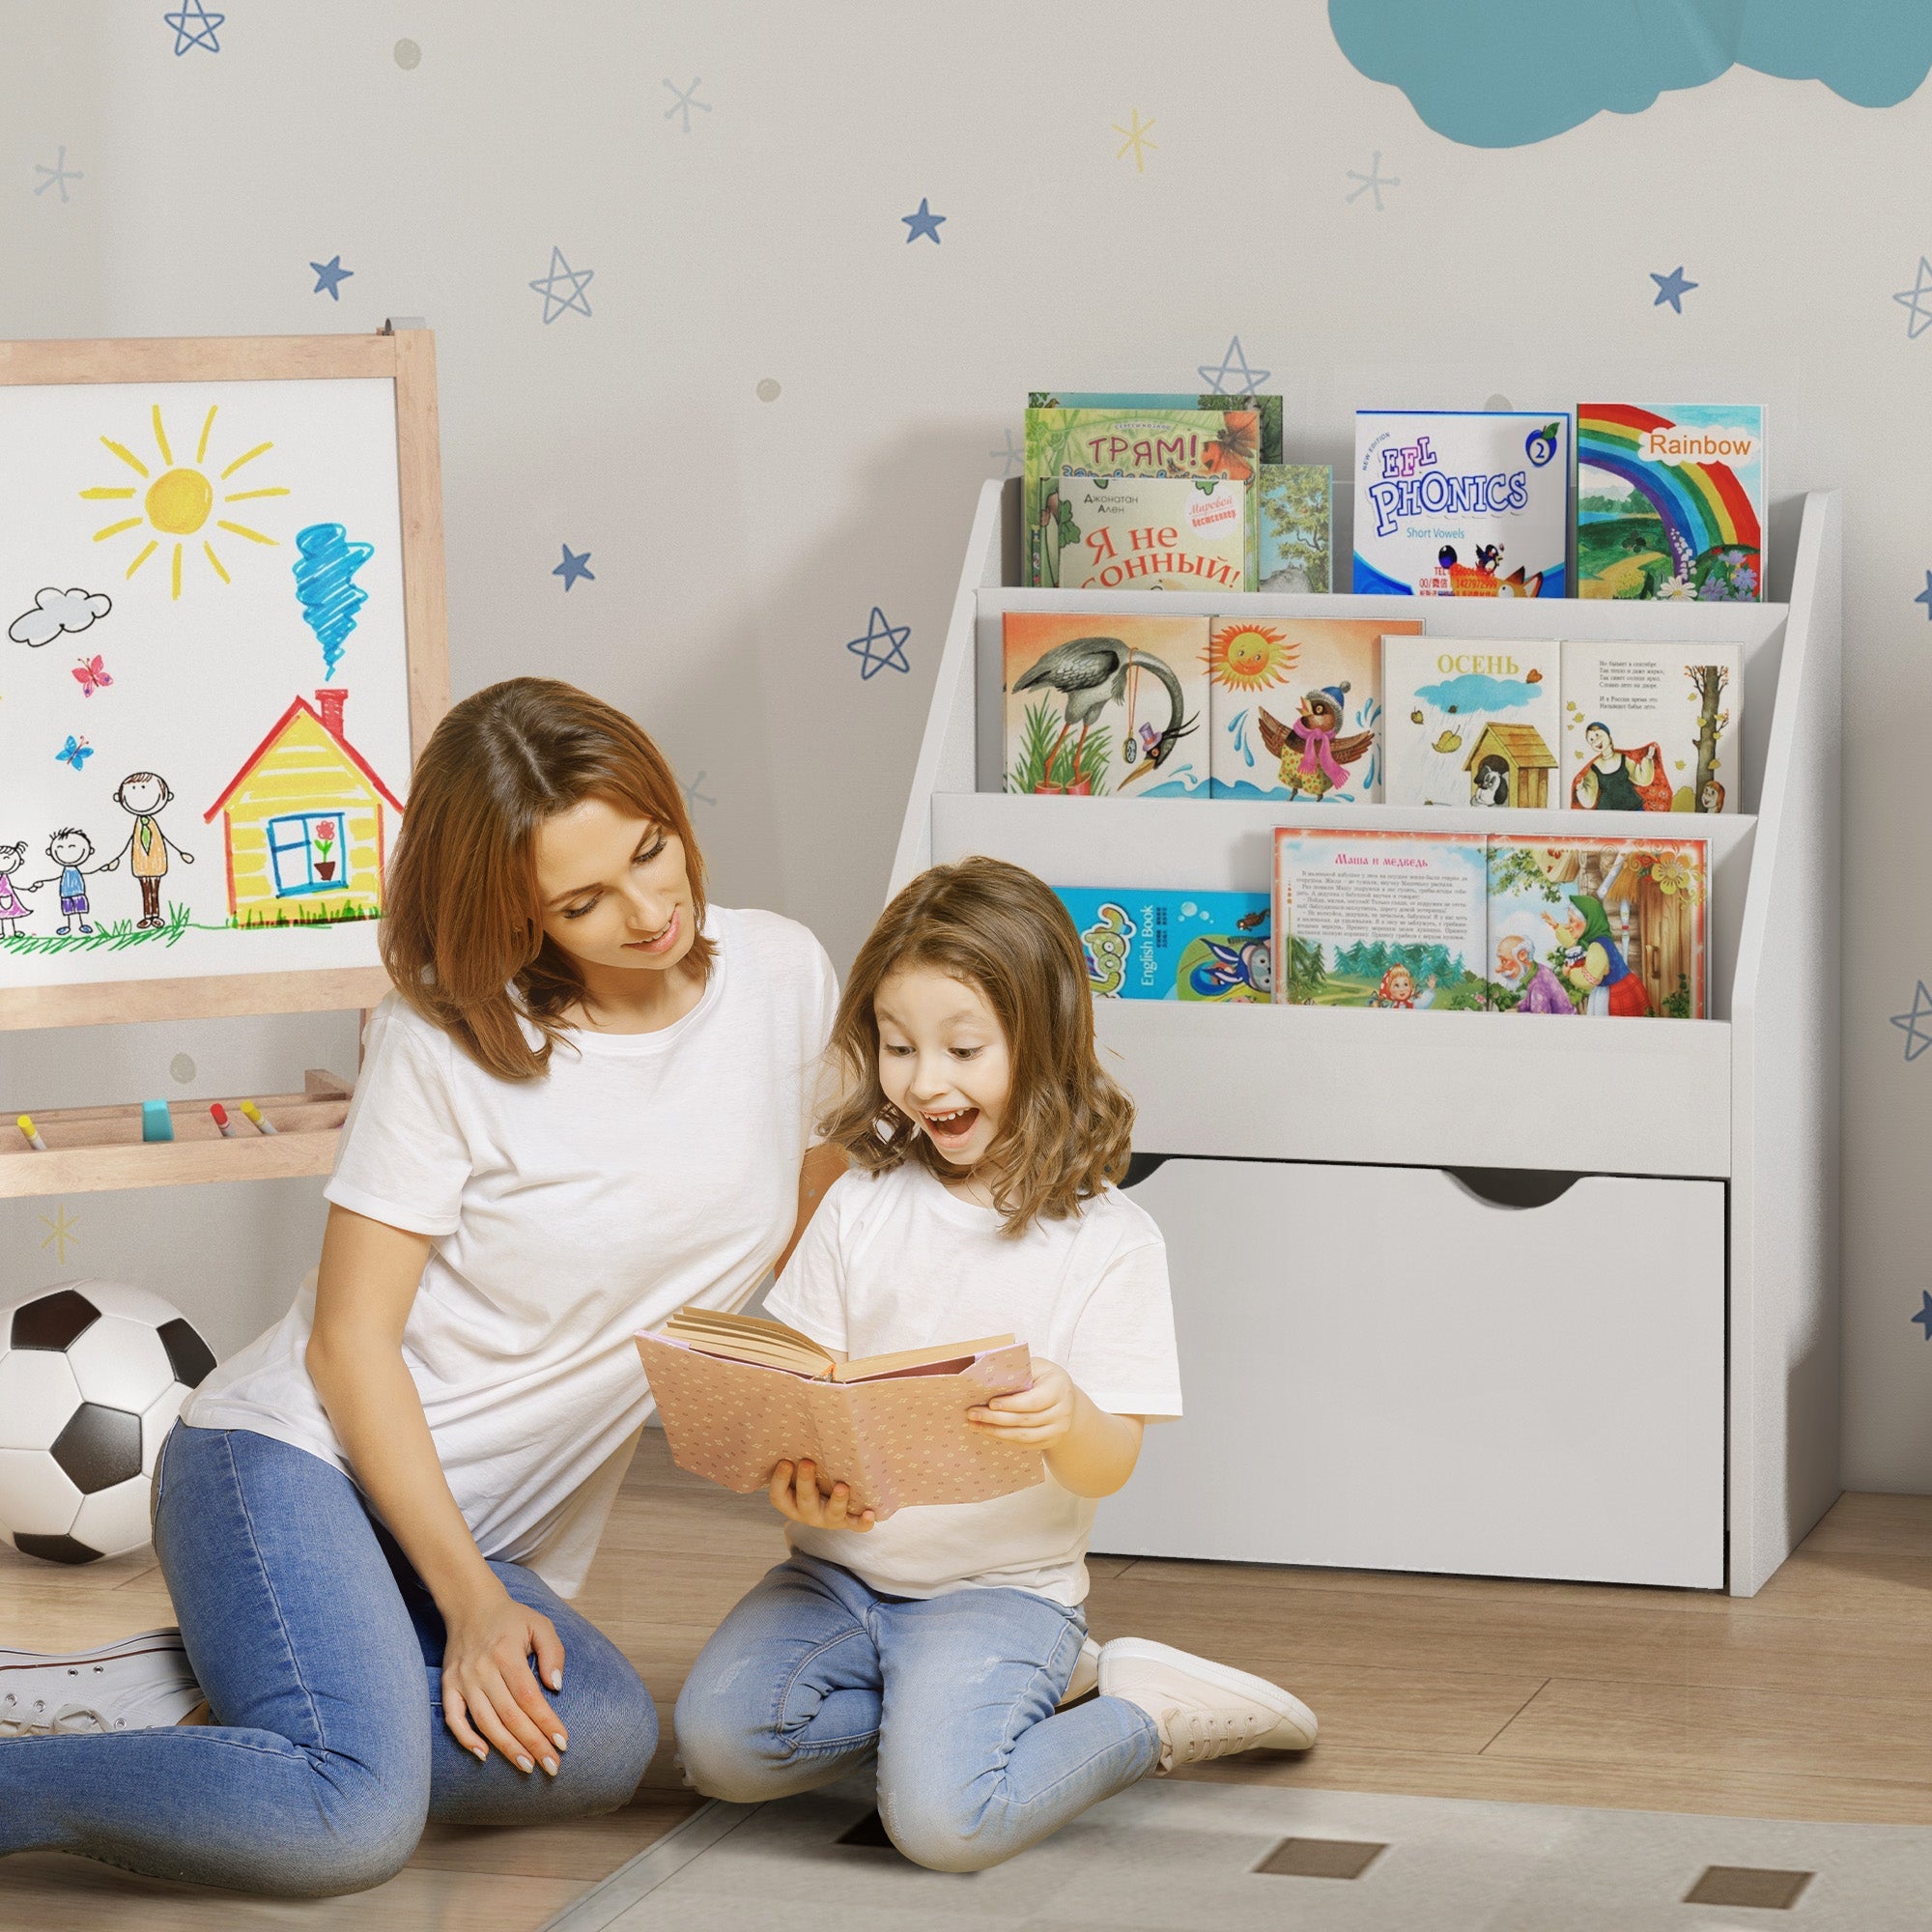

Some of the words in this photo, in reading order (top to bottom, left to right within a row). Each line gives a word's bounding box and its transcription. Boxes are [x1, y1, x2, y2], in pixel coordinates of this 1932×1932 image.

[1088, 434, 1198, 467] ТРЯМ!
[1368, 431, 1391, 453] EDITION
[1535, 441, 1545, 459] 2
[1649, 434, 1752, 456] Rainbow
[1382, 436, 1437, 479] EFL
[1083, 494, 1139, 504] Джонатан
[1368, 470, 1529, 538] PHONICS
[1406, 526, 1431, 539] Short
[1433, 527, 1465, 539] Vowels
[1085, 526, 1119, 567] Я
[1127, 526, 1179, 552] не
[1436, 653, 1520, 675] ОСЕНЬ
[1334, 853, 1369, 866] Маша
[1382, 857, 1429, 868] медведь
[1140, 904, 1154, 938] Book
[1140, 941, 1158, 986] English
